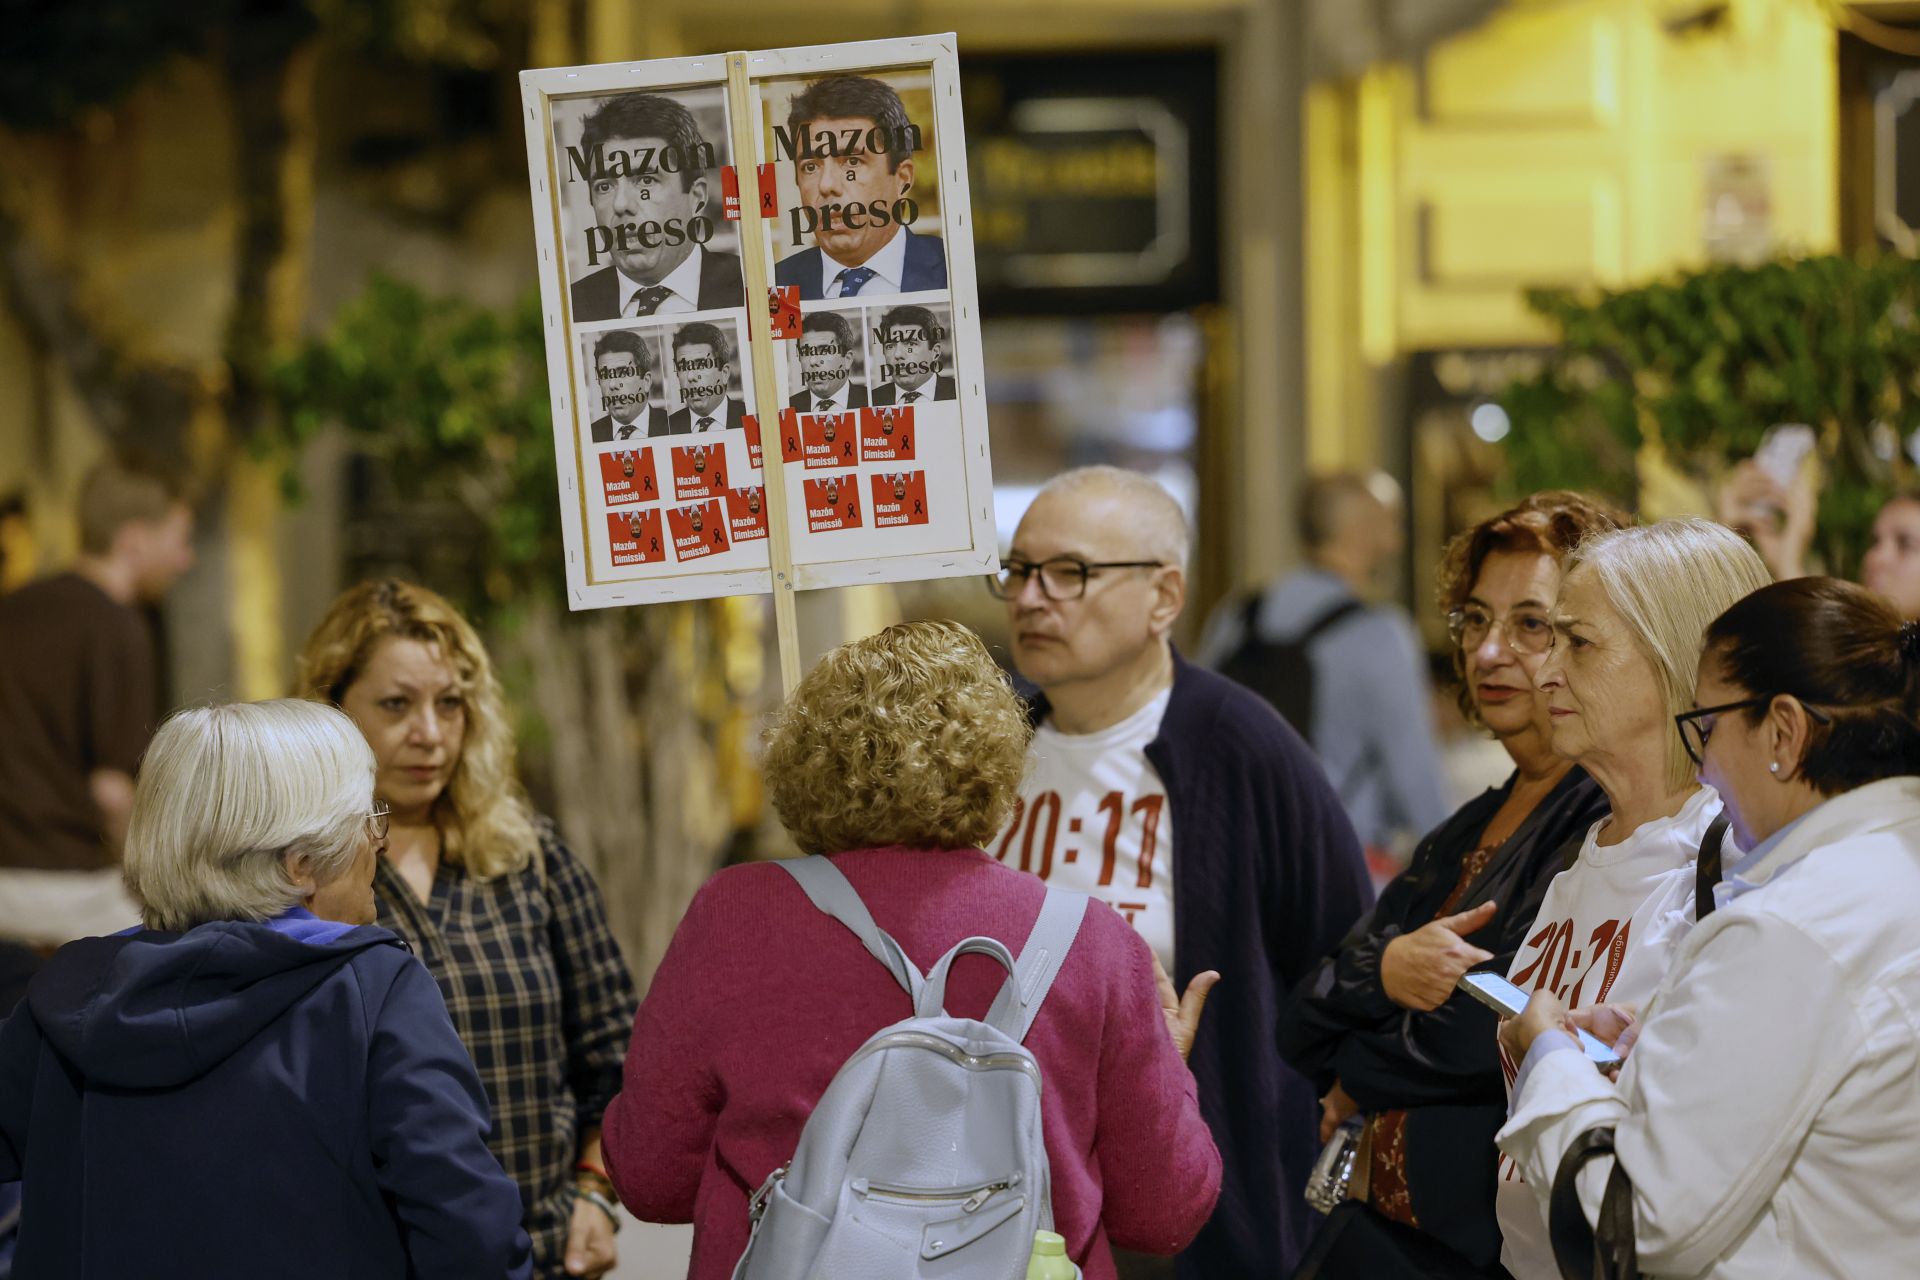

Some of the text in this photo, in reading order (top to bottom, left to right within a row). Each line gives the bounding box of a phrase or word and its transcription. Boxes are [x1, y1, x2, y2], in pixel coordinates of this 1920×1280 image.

[846, 169, 857, 182] a
[640, 188, 651, 200] a
[788, 183, 920, 246] presó
[584, 201, 715, 266] presó
[800, 364, 846, 386] presó
[679, 379, 724, 404] presó
[601, 387, 646, 412] presó
[864, 437, 888, 447] Mazón
[806, 443, 831, 455] Mazón
[864, 448, 896, 459] Dimissió
[807, 455, 838, 467] Dimissió
[606, 480, 631, 492] Mazón
[676, 475, 701, 487] Mazón
[608, 491, 639, 504] Dimissió
[678, 486, 709, 499] Dimissió
[809, 507, 834, 519] Mazón
[876, 502, 901, 513] Mazón
[732, 516, 757, 528] Mazón
[811, 518, 843, 531] Dimissió
[877, 513, 909, 526] Dimissió
[734, 527, 766, 540] Dimissió
[613, 540, 637, 552] Mazón
[675, 534, 701, 548] Mazón
[614, 552, 646, 564] Dimissió
[679, 545, 711, 560] Dimissió
